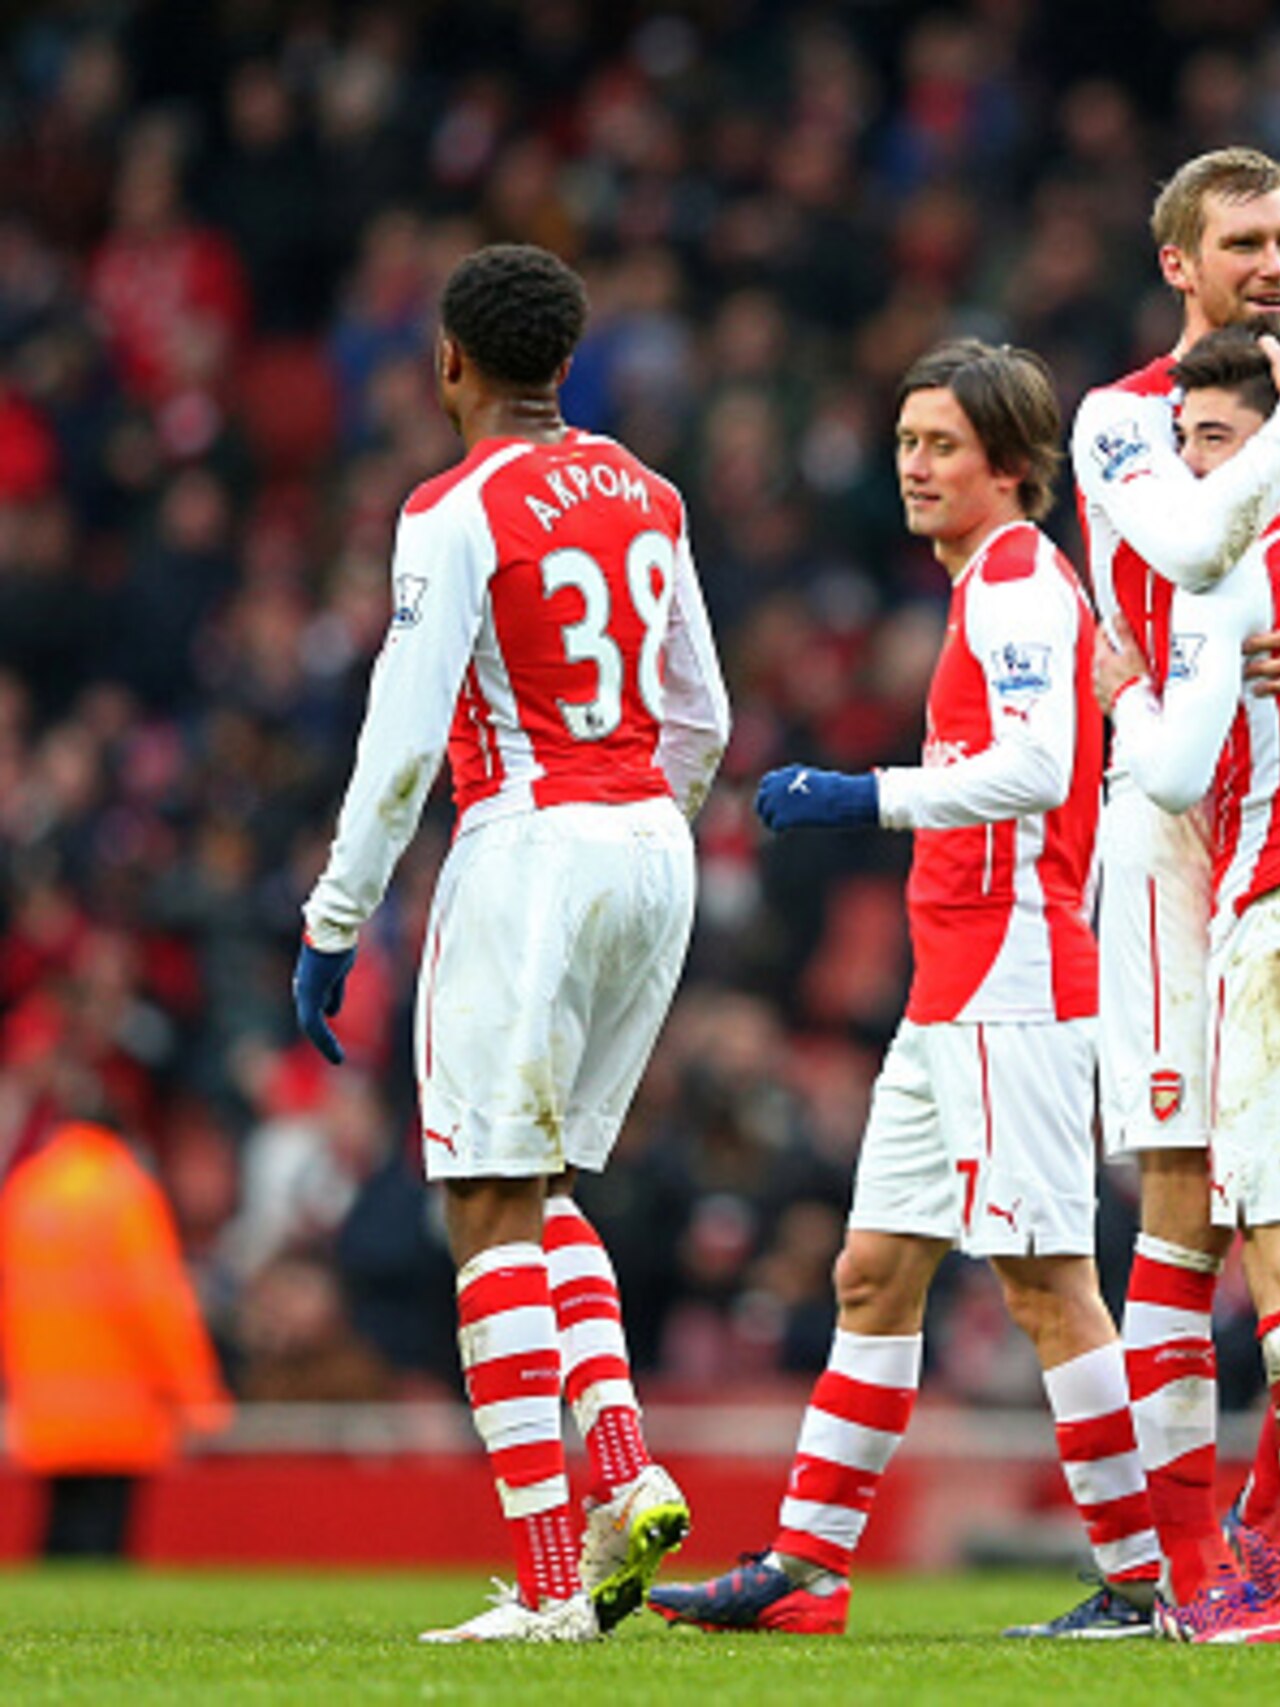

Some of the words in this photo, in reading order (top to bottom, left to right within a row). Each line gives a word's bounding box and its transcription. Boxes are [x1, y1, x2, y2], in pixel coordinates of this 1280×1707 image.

[526, 464, 649, 531] AKPOM
[541, 531, 674, 740] 38
[956, 1158, 979, 1234] 7
